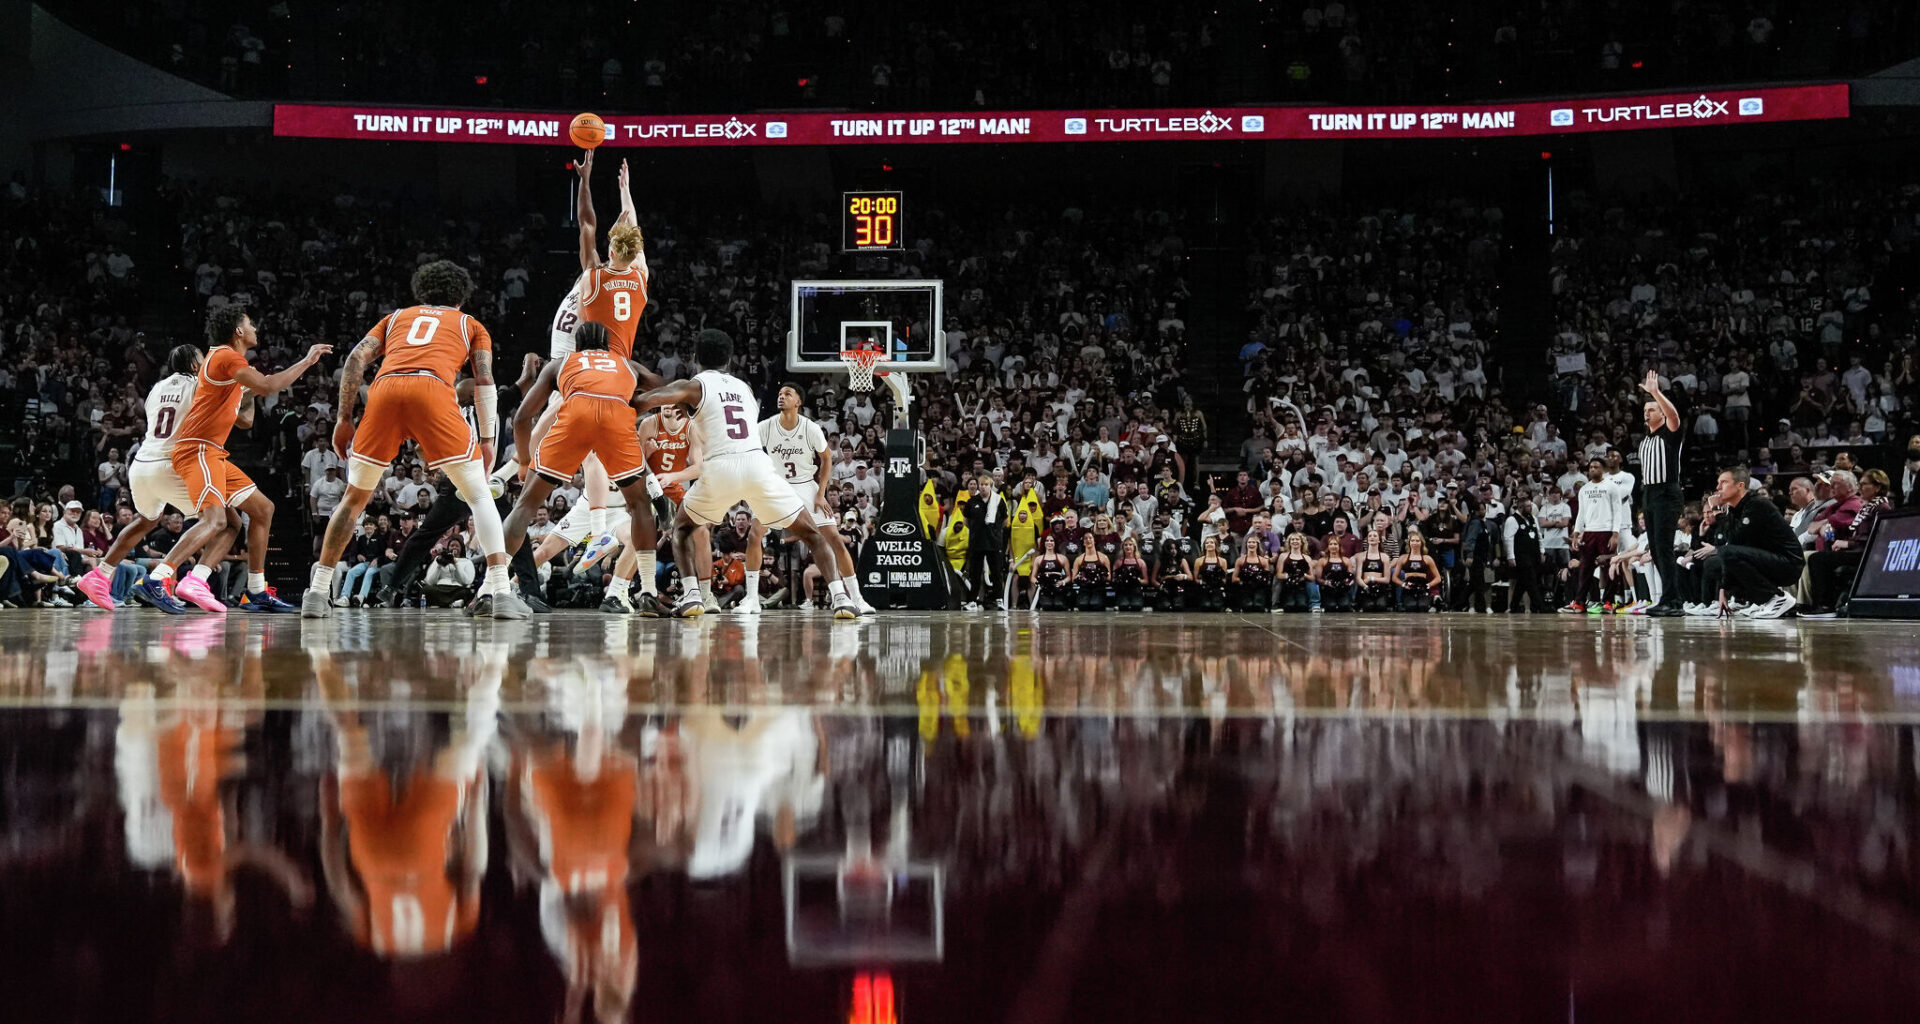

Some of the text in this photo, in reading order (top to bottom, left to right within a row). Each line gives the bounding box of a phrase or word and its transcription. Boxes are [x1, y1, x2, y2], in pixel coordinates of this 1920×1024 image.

[1582, 94, 1729, 123] TURTLEBOX
[354, 114, 559, 137] TURN IT UP 12TH MAN!
[623, 116, 757, 139] TURTLEBOX
[830, 117, 1030, 136] TURN IT UP 12TH MAN!
[1094, 110, 1233, 133] TURTLEBOX
[1308, 111, 1515, 131] TURN IT UP 12TH MAN!
[850, 197, 897, 214] 20:00
[856, 215, 892, 245] 30
[613, 291, 631, 322] 8
[406, 315, 441, 346] 0
[556, 309, 578, 334] 12
[1800, 317, 1814, 333] 12
[578, 356, 618, 373] 12
[160, 394, 181, 403] HILL
[718, 391, 743, 403] LANE
[154, 406, 177, 439] 0
[723, 404, 749, 440] 5
[656, 439, 687, 450] Texas
[771, 443, 804, 460] Aggies
[660, 452, 676, 472] 5
[784, 462, 797, 479] 3
[886, 522, 910, 534] Ford
[876, 541, 922, 552] WELLS
[1882, 538, 1920, 572] TURN
[876, 554, 922, 566] FARGO
[890, 571, 932, 581] KING RANCH
